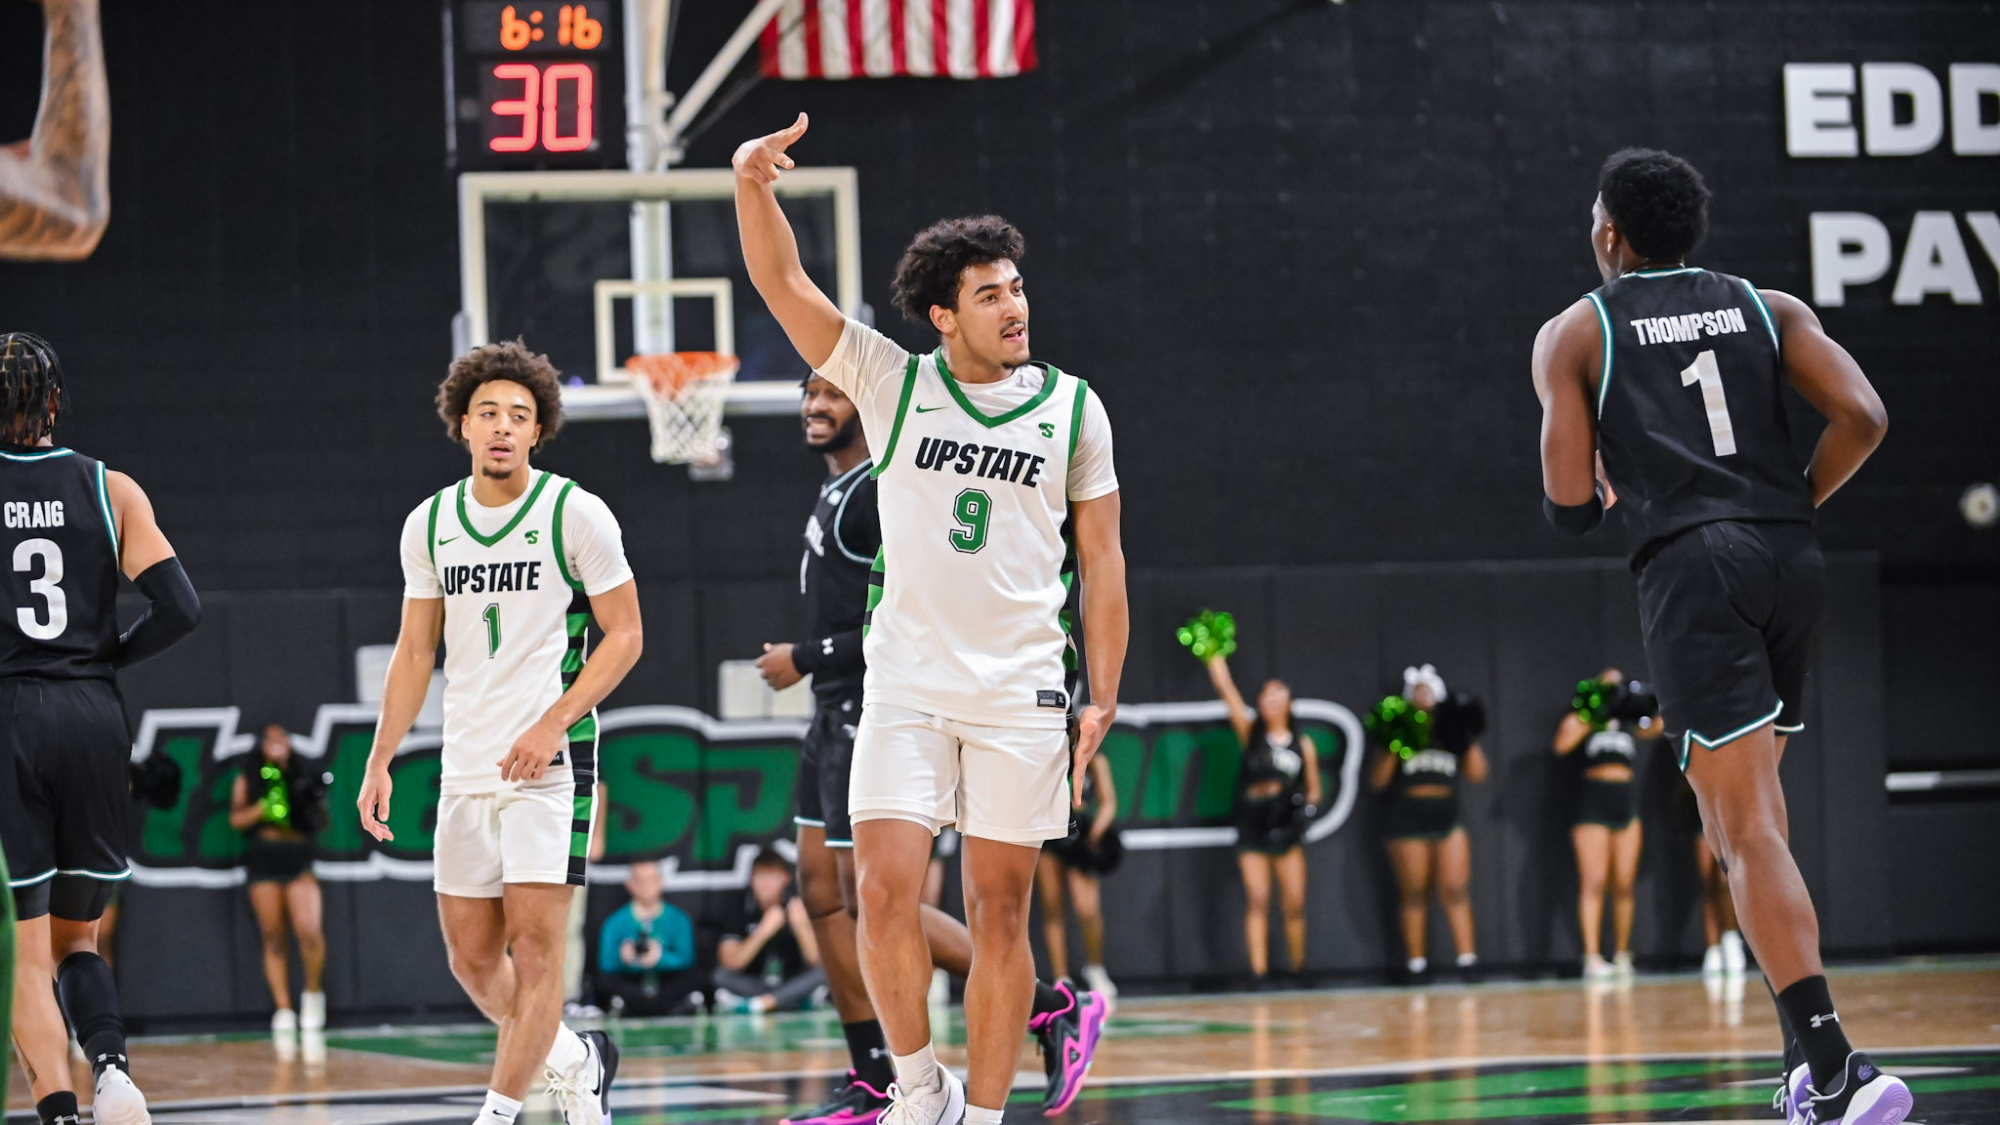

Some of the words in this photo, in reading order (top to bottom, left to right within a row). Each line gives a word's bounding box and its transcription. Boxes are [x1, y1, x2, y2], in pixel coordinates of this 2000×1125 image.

[500, 4, 602, 50] 6:16
[490, 64, 593, 152] 30
[1630, 307, 1747, 345] THOMPSON
[1680, 349, 1737, 457] 1
[915, 437, 1046, 488] UPSTATE
[4, 501, 64, 528] CRAIG
[949, 488, 992, 554] 9
[13, 538, 67, 640] 3
[444, 561, 541, 595] UPSTATE
[482, 603, 501, 659] 1
